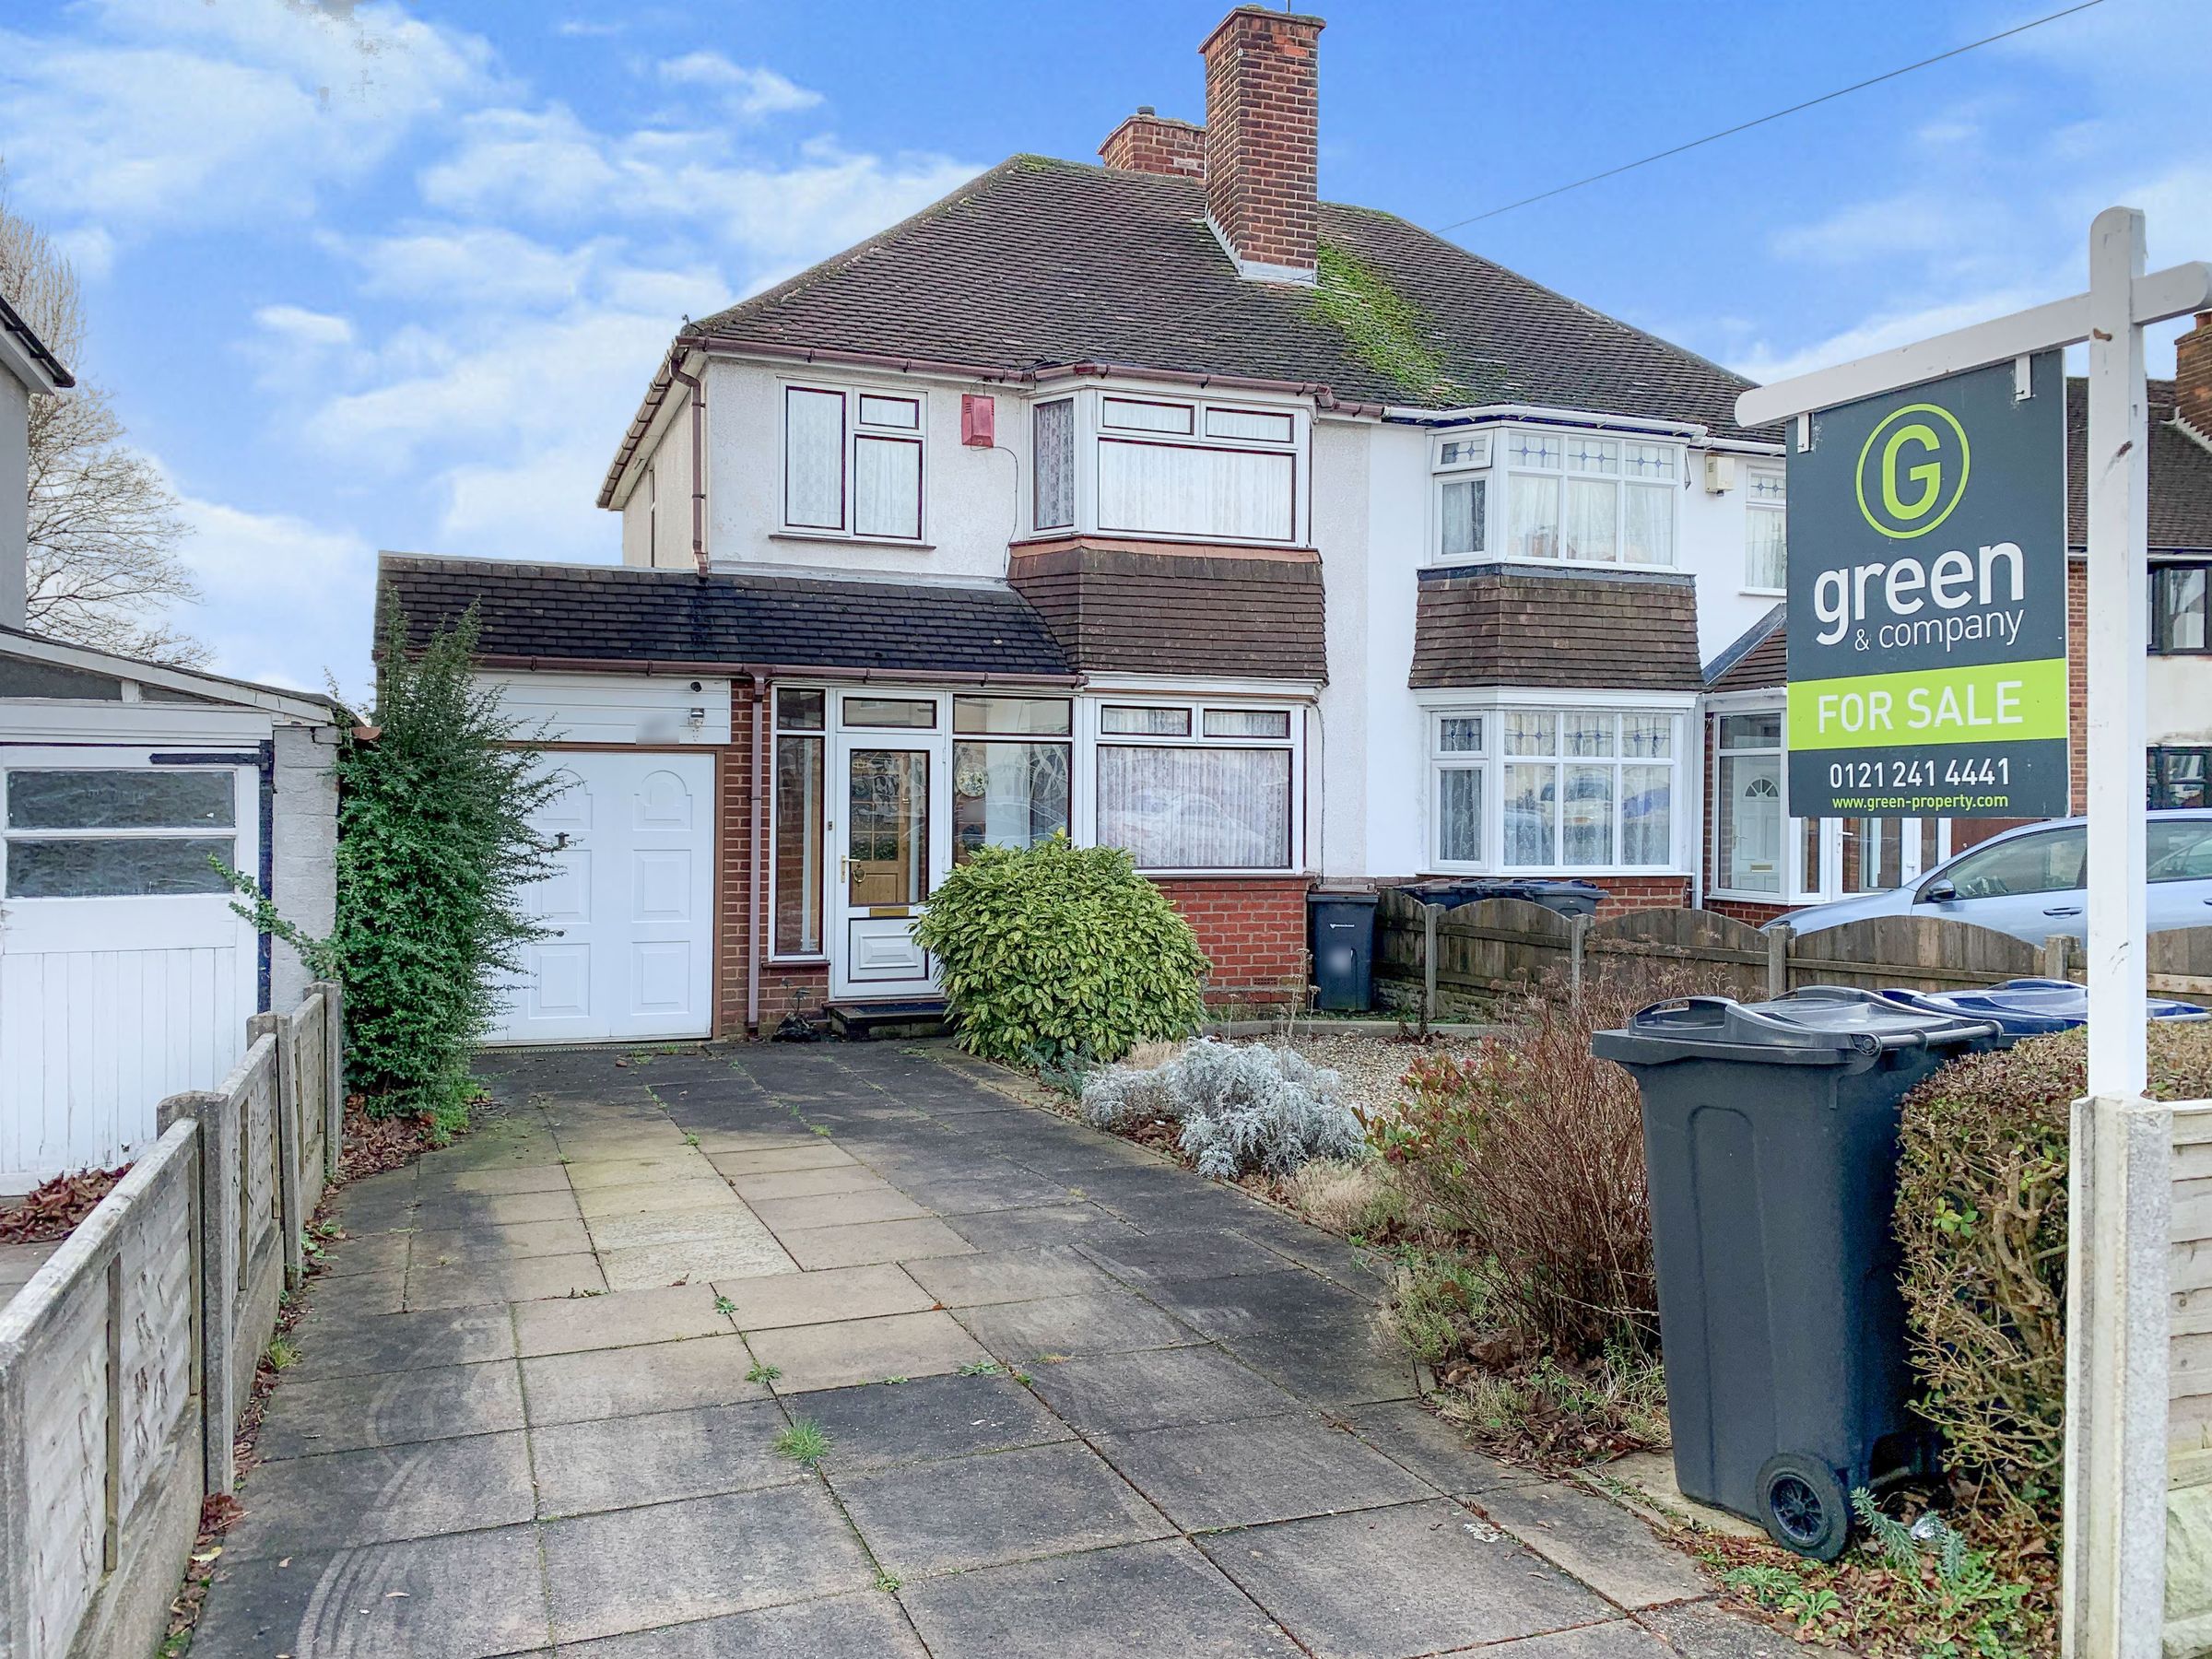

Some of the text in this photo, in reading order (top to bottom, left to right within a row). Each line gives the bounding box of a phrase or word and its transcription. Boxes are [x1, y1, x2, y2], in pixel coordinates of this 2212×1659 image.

[1882, 424, 1941, 520] G
[1814, 542, 2024, 645] green
[1854, 609, 2024, 652] & company
[1818, 680, 2023, 734] FOR SALE
[1830, 757, 2009, 789] 0121 241 4441
[1832, 794, 2008, 812] www.green-property.com
